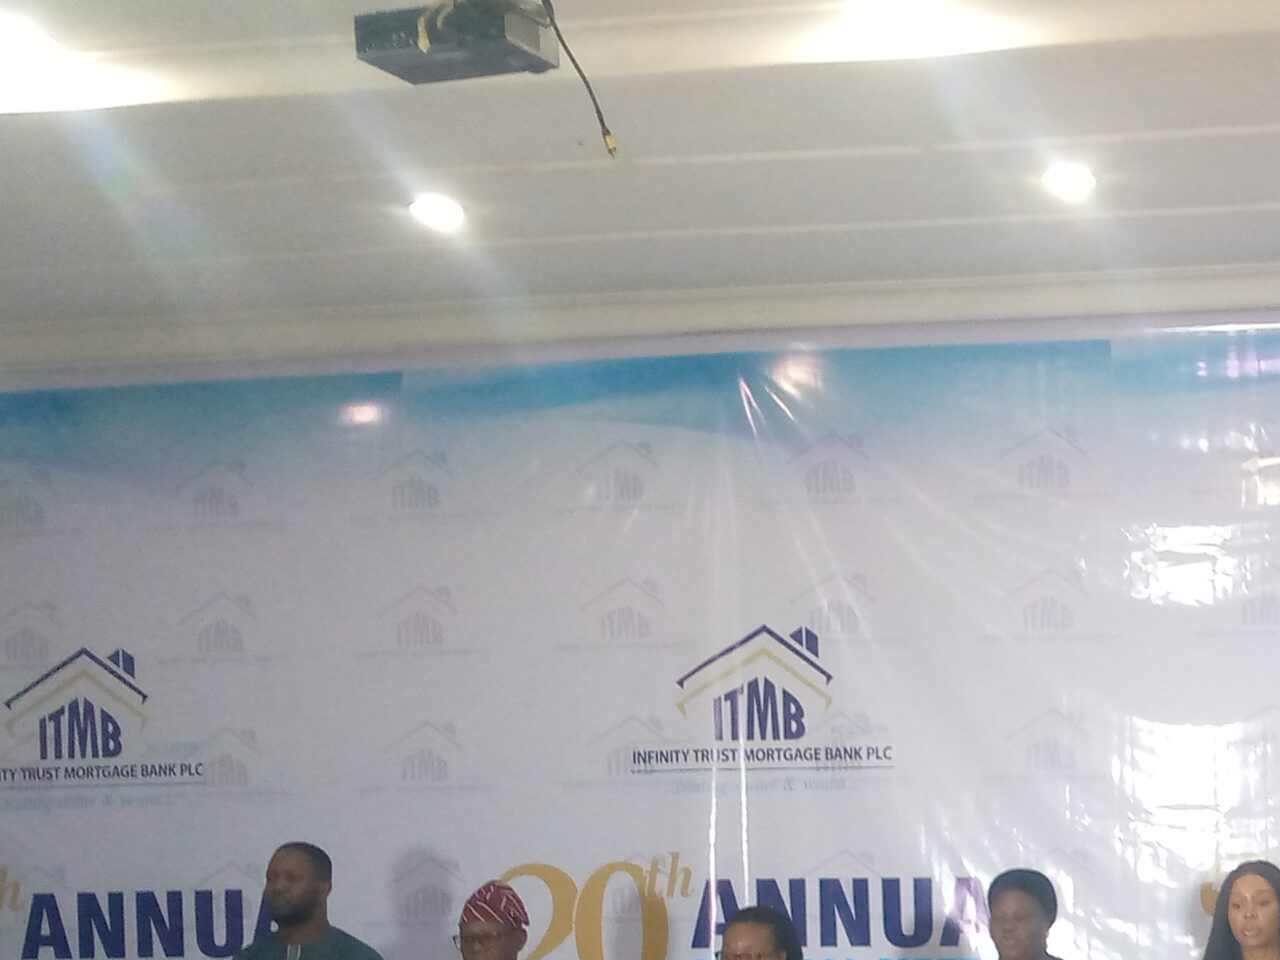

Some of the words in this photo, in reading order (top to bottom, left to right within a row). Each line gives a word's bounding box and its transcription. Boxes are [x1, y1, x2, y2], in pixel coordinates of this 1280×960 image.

[39, 697, 122, 760] ITMB
[713, 677, 805, 741] ITMB
[20, 766, 61, 781] TRUST
[64, 764, 137, 780] MORTGAGE
[141, 763, 177, 778] BANK
[180, 762, 204, 777] PLC
[633, 749, 690, 765] INFINITY
[692, 748, 738, 764] TRUST
[743, 746, 821, 763] MORTGAGE
[825, 746, 862, 761] BANK
[866, 745, 892, 760] PLC
[21, 889, 272, 960] ANNU
[691, 878, 990, 949] ANNUA
